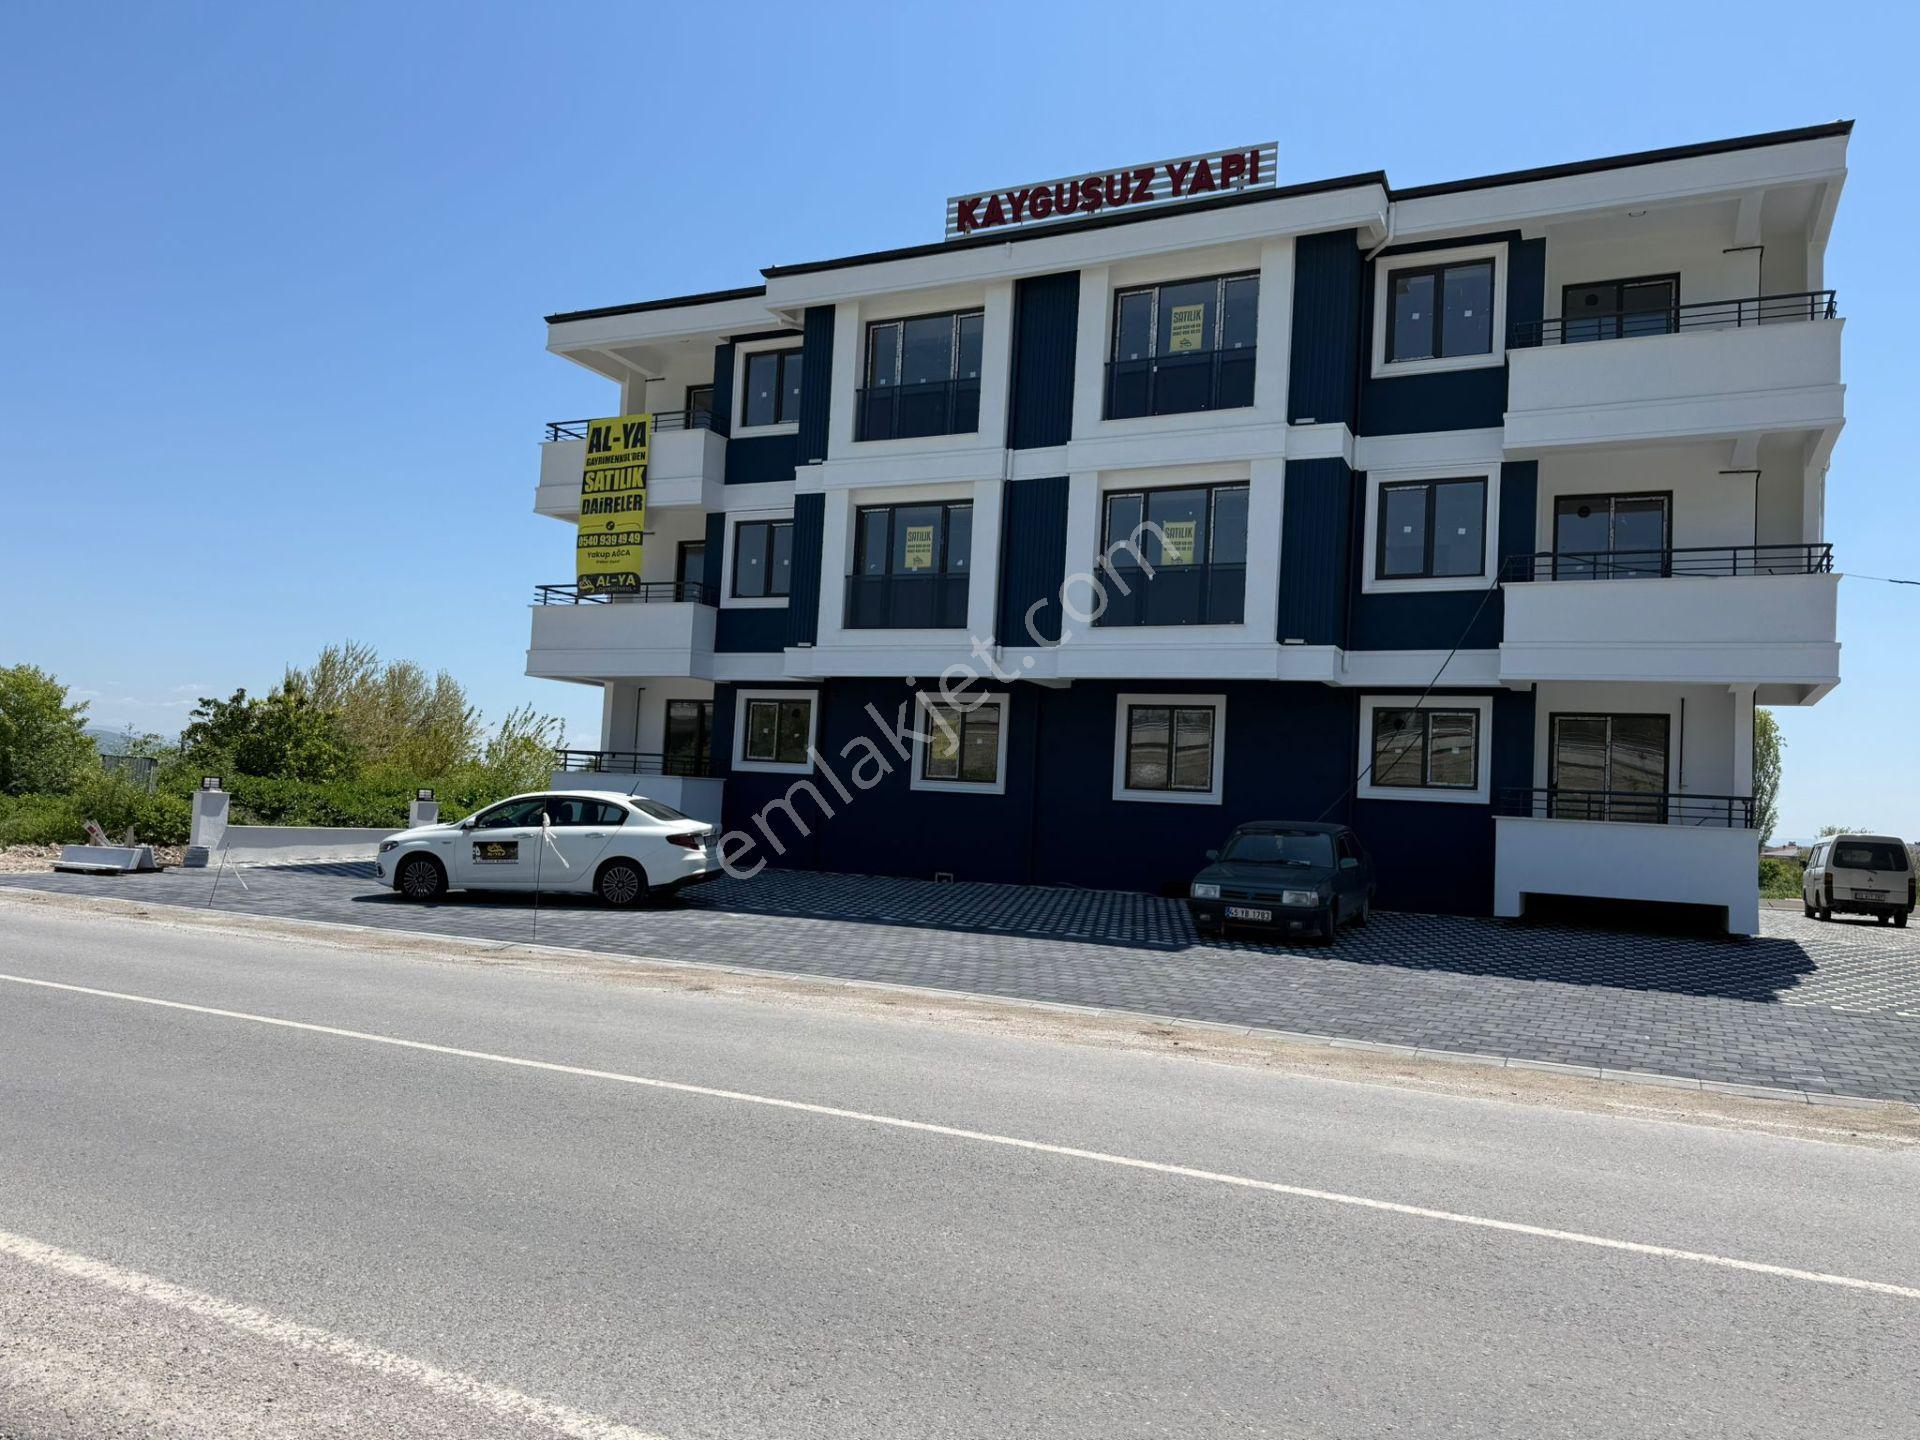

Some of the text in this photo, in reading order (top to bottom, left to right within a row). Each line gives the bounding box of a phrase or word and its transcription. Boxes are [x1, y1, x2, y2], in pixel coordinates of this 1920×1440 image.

[957, 149, 1260, 232] KAYGUSUZ YAPI
[1173, 309, 1201, 323] SATILIK
[588, 422, 647, 454] AL-YA
[584, 466, 645, 492] SATILIK
[907, 531, 931, 542] SATILIK
[1165, 527, 1193, 538] SATILIK
[587, 551, 610, 560] Yakup
[596, 574, 636, 587] AL-YA
